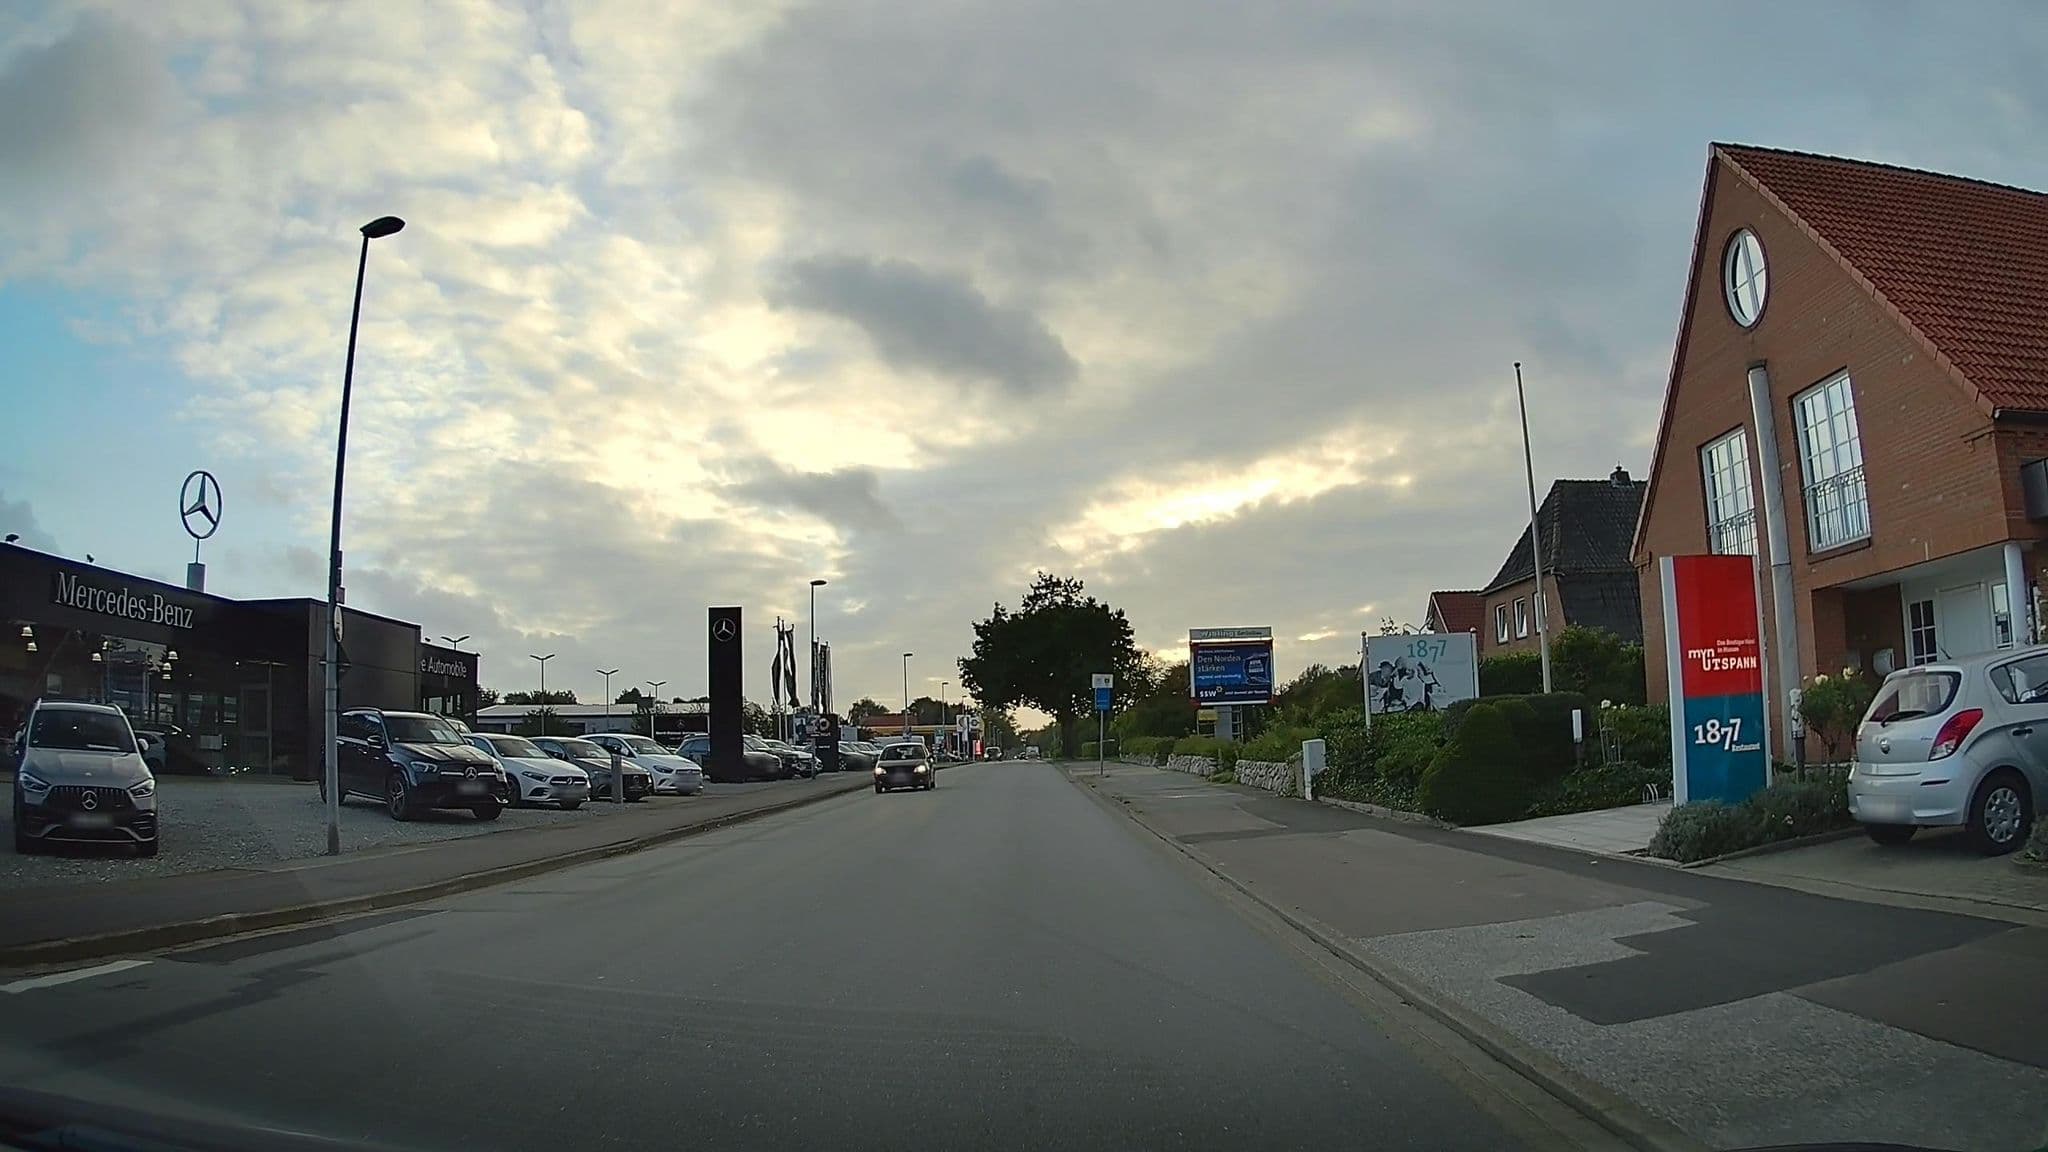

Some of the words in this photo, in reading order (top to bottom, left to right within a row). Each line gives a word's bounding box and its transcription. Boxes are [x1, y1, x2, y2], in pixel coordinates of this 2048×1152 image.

[55, 571, 193, 629] Mercedes-Benz
[1198, 655, 1213, 664] Den
[1214, 654, 1242, 663] Norden
[1407, 639, 1447, 663] 1877
[1688, 648, 1715, 660] myn
[428, 656, 467, 678] Automobile
[1702, 656, 1757, 671] UTSPANN
[1694, 718, 1741, 750] 1877
